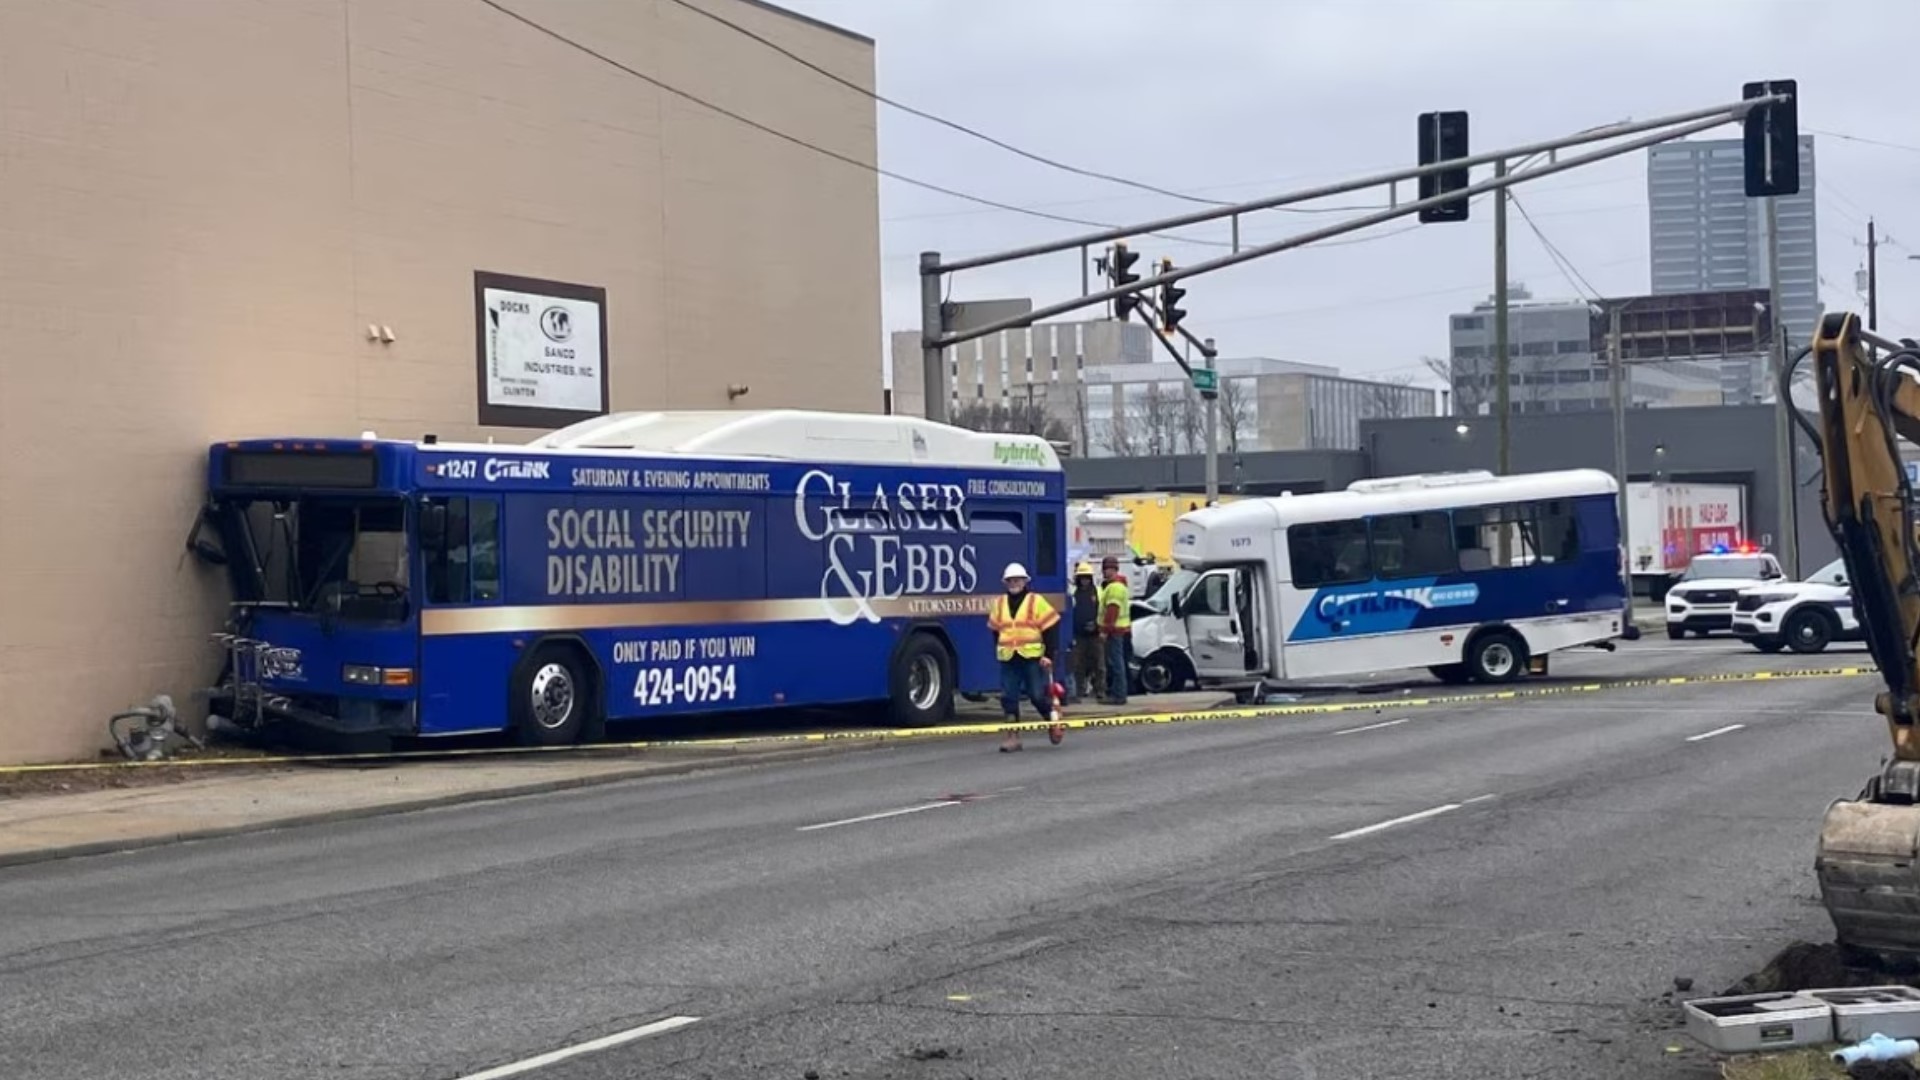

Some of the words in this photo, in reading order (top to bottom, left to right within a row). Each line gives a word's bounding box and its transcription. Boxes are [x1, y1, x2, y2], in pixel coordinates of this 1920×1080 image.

[500, 301, 530, 315] DOCKS
[545, 347, 575, 359] SANCO
[994, 441, 1039, 464] hybrid
[572, 468, 629, 487] SATURDAY
[633, 470, 641, 488] &
[644, 471, 690, 488] EVENING
[693, 472, 770, 490] APPOINTMENTS
[967, 479, 987, 495] FREE
[795, 469, 969, 541] GLASER
[547, 509, 635, 549] SOCIAL
[643, 510, 752, 549] SECURITY
[547, 554, 680, 595] DISABILITY
[820, 534, 882, 626] &
[870, 535, 977, 602] EBBS
[908, 600, 963, 613] ATTORNEYS
[613, 642, 648, 664] ONLY
[651, 640, 682, 662] PAID
[685, 640, 696, 661] IF
[700, 638, 727, 659] YOU
[729, 636, 756, 658] WIN
[633, 664, 737, 706] 424-0954
